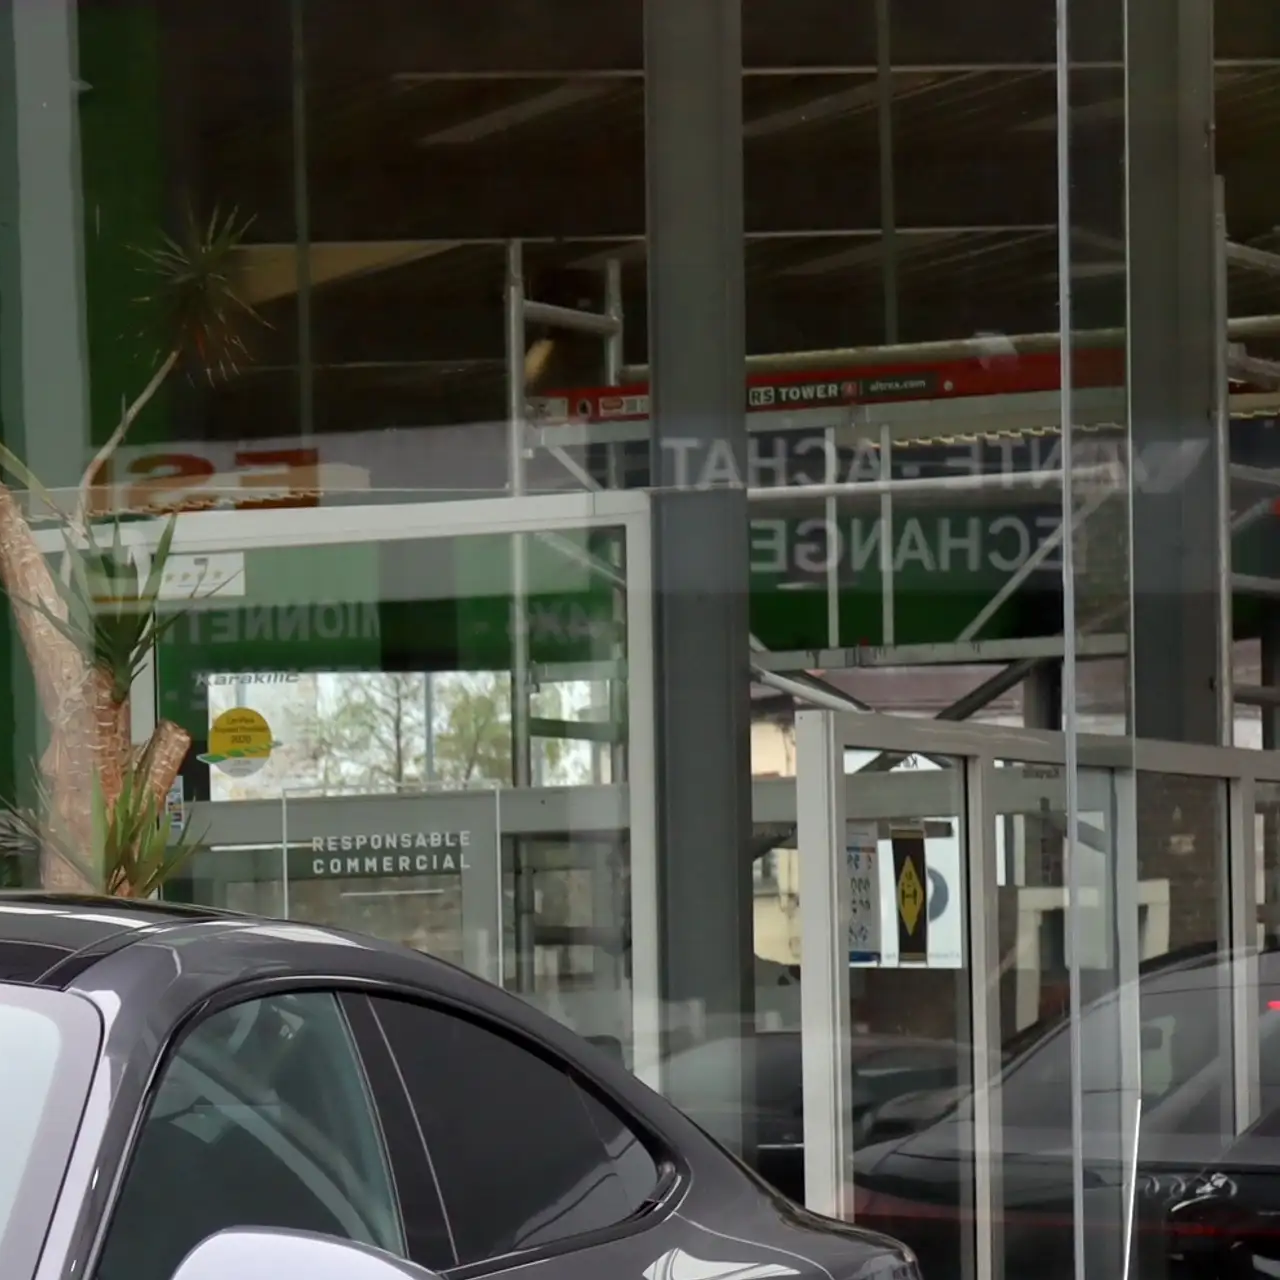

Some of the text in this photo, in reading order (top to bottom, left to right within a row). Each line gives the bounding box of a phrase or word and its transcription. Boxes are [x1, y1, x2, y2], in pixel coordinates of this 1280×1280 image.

[780, 384, 839, 401] TOWER
[311, 830, 472, 852] RESPONSABLE
[311, 853, 472, 876] COMMERCIAL
